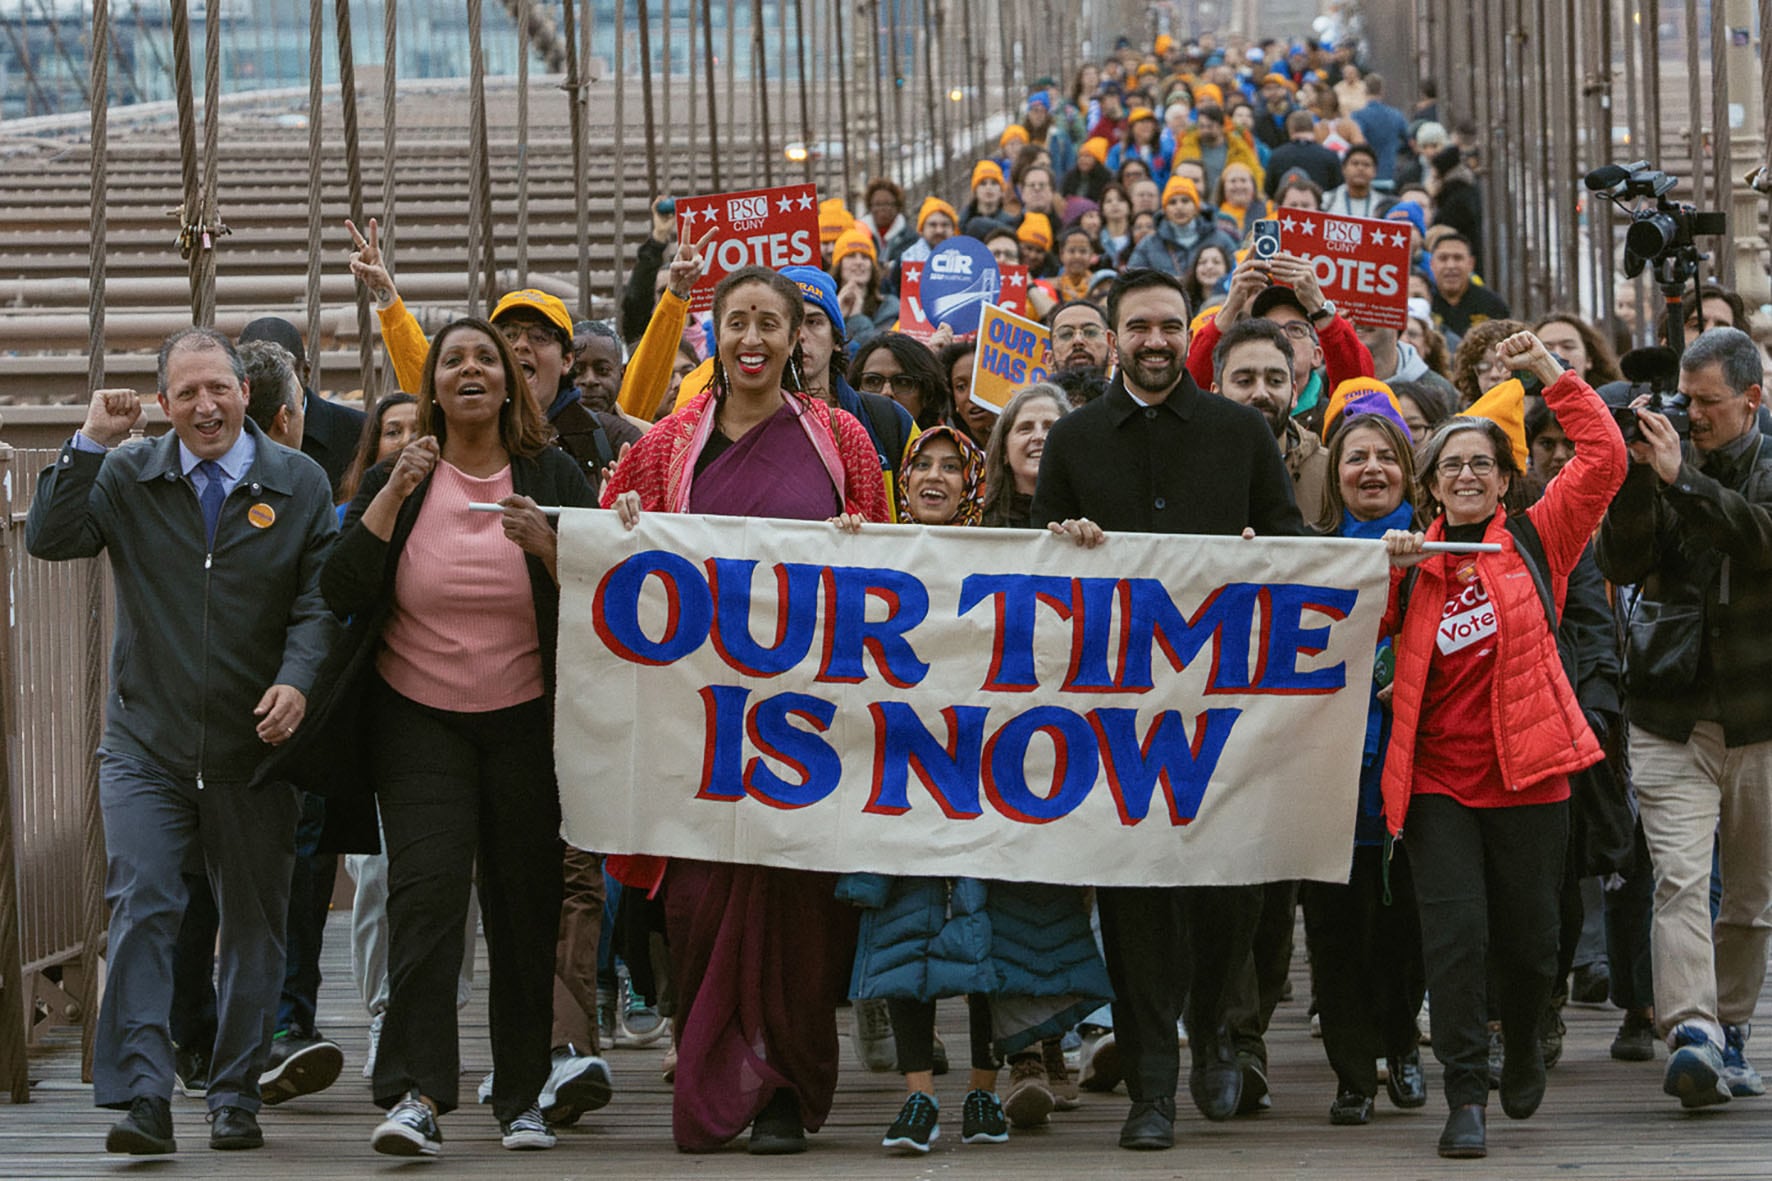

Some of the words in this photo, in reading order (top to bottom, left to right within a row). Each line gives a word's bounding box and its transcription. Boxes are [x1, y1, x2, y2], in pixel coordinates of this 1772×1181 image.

[728, 196, 768, 220] PSC
[733, 219, 765, 231] CUNY
[1324, 220, 1362, 243] PSC
[1326, 241, 1357, 253] CUNY
[1283, 249, 1399, 295] OTES
[989, 317, 1036, 358] OUR
[981, 344, 1027, 384] HAS
[592, 550, 931, 689] OUR
[958, 573, 1359, 696] TIME
[694, 684, 842, 810] IS
[861, 701, 1243, 827] NOW
